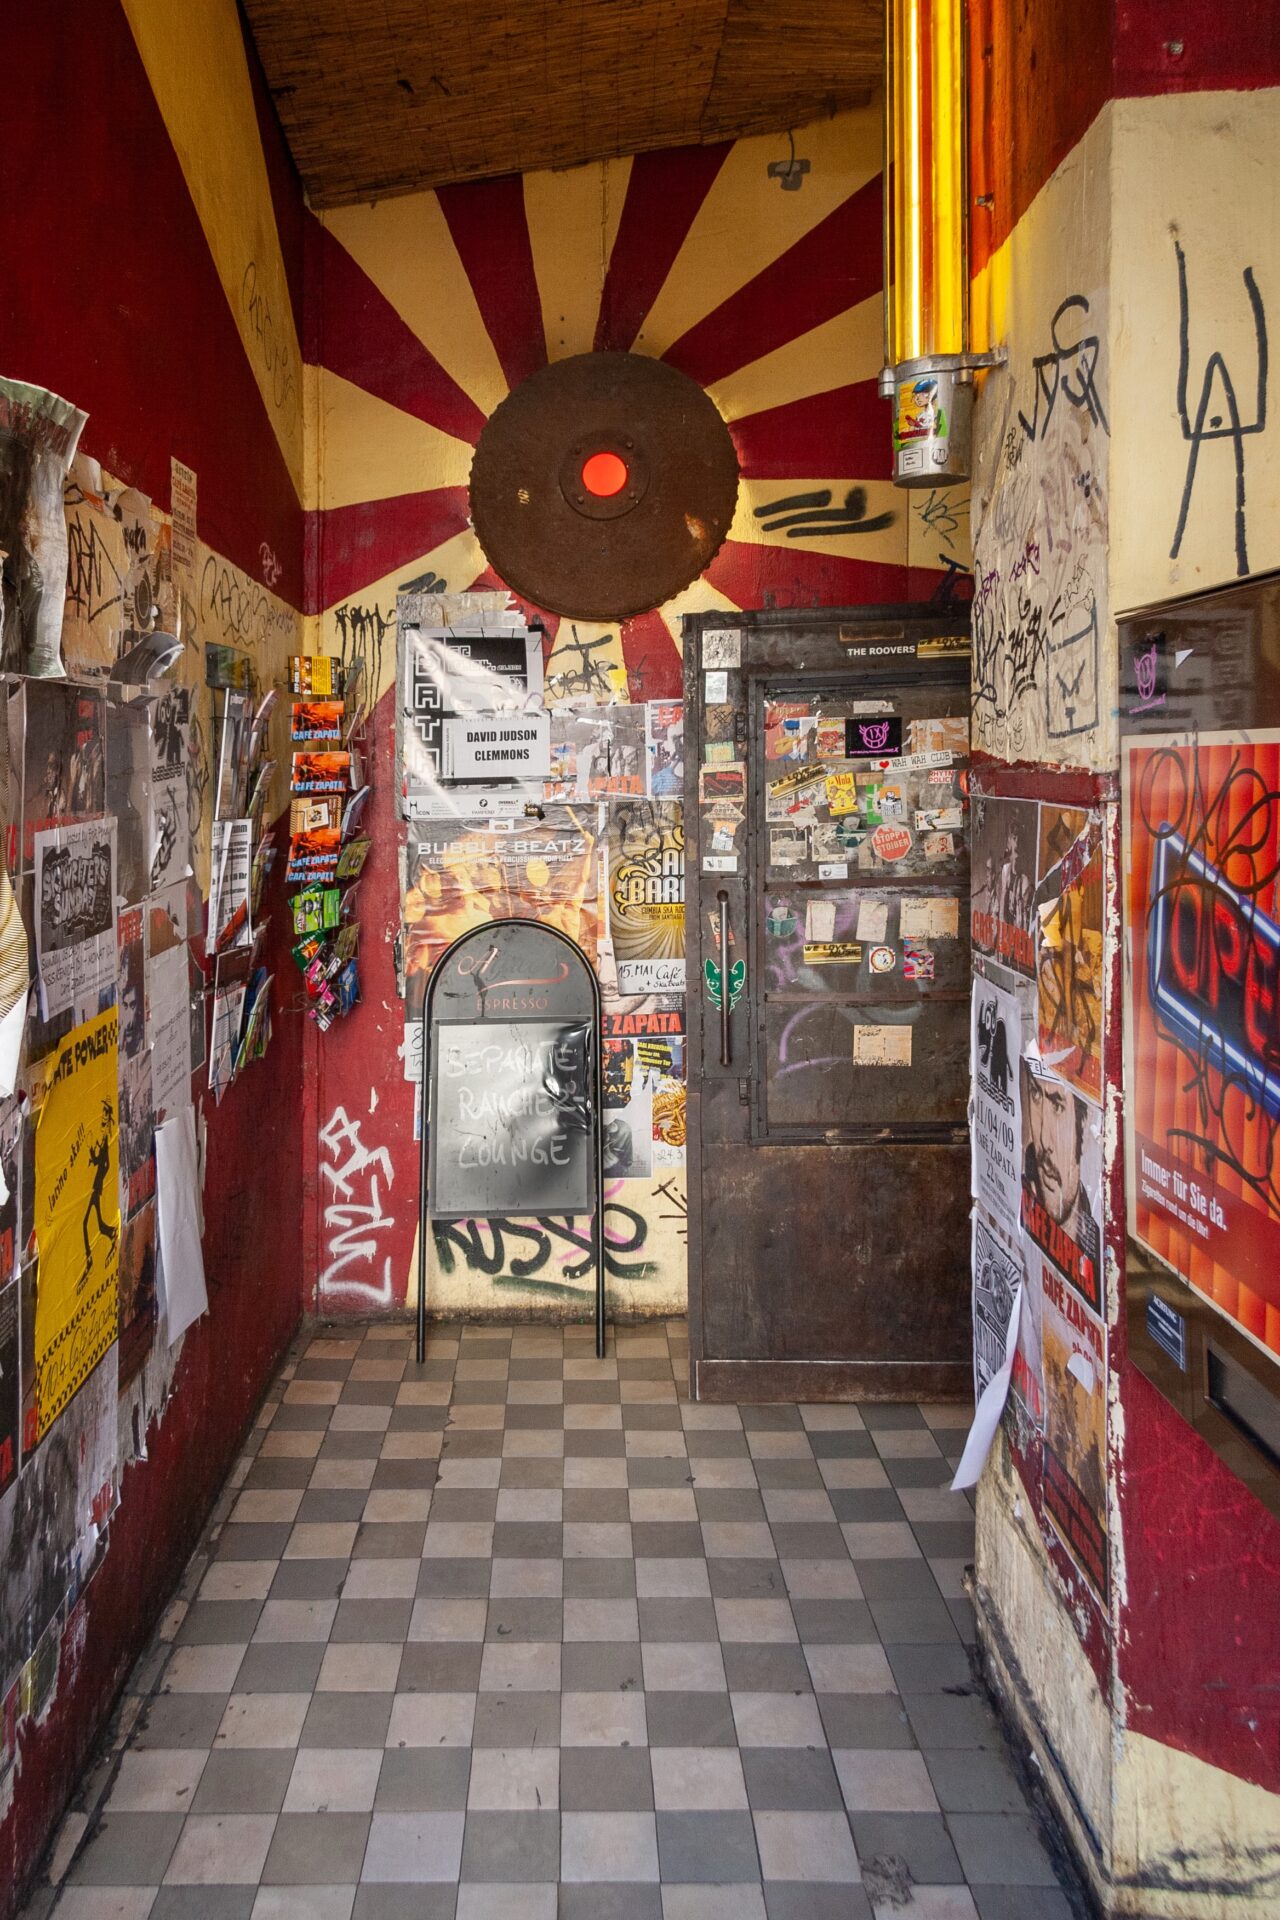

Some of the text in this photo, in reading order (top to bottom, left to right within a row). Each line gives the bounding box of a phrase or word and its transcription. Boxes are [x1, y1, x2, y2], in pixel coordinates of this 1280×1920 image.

[847, 645, 916, 656] THE ROOVERS
[467, 729, 538, 743] DAVID JUDSON
[474, 748, 530, 761] CLEMMONS
[891, 759, 907, 768] WAH
[911, 755, 927, 765] WAH
[930, 751, 951, 763] CLUB
[876, 831, 905, 844] STOPPT
[876, 838, 909, 851] STOIBER
[417, 839, 586, 855] BUBBLE BEATZ
[663, 905, 674, 914] SKA
[656, 963, 681, 983] Café
[476, 996, 549, 1011] ESPRESSO
[612, 1012, 681, 1035] ZAPATA
[976, 1099, 1015, 1153] 11/04/09
[458, 1134, 571, 1168] LOUNGE
[990, 1137, 1017, 1182] ZAPATA
[1141, 1148, 1228, 1231] Immer für Sie da.
[1041, 1263, 1064, 1315] CAFÉ
